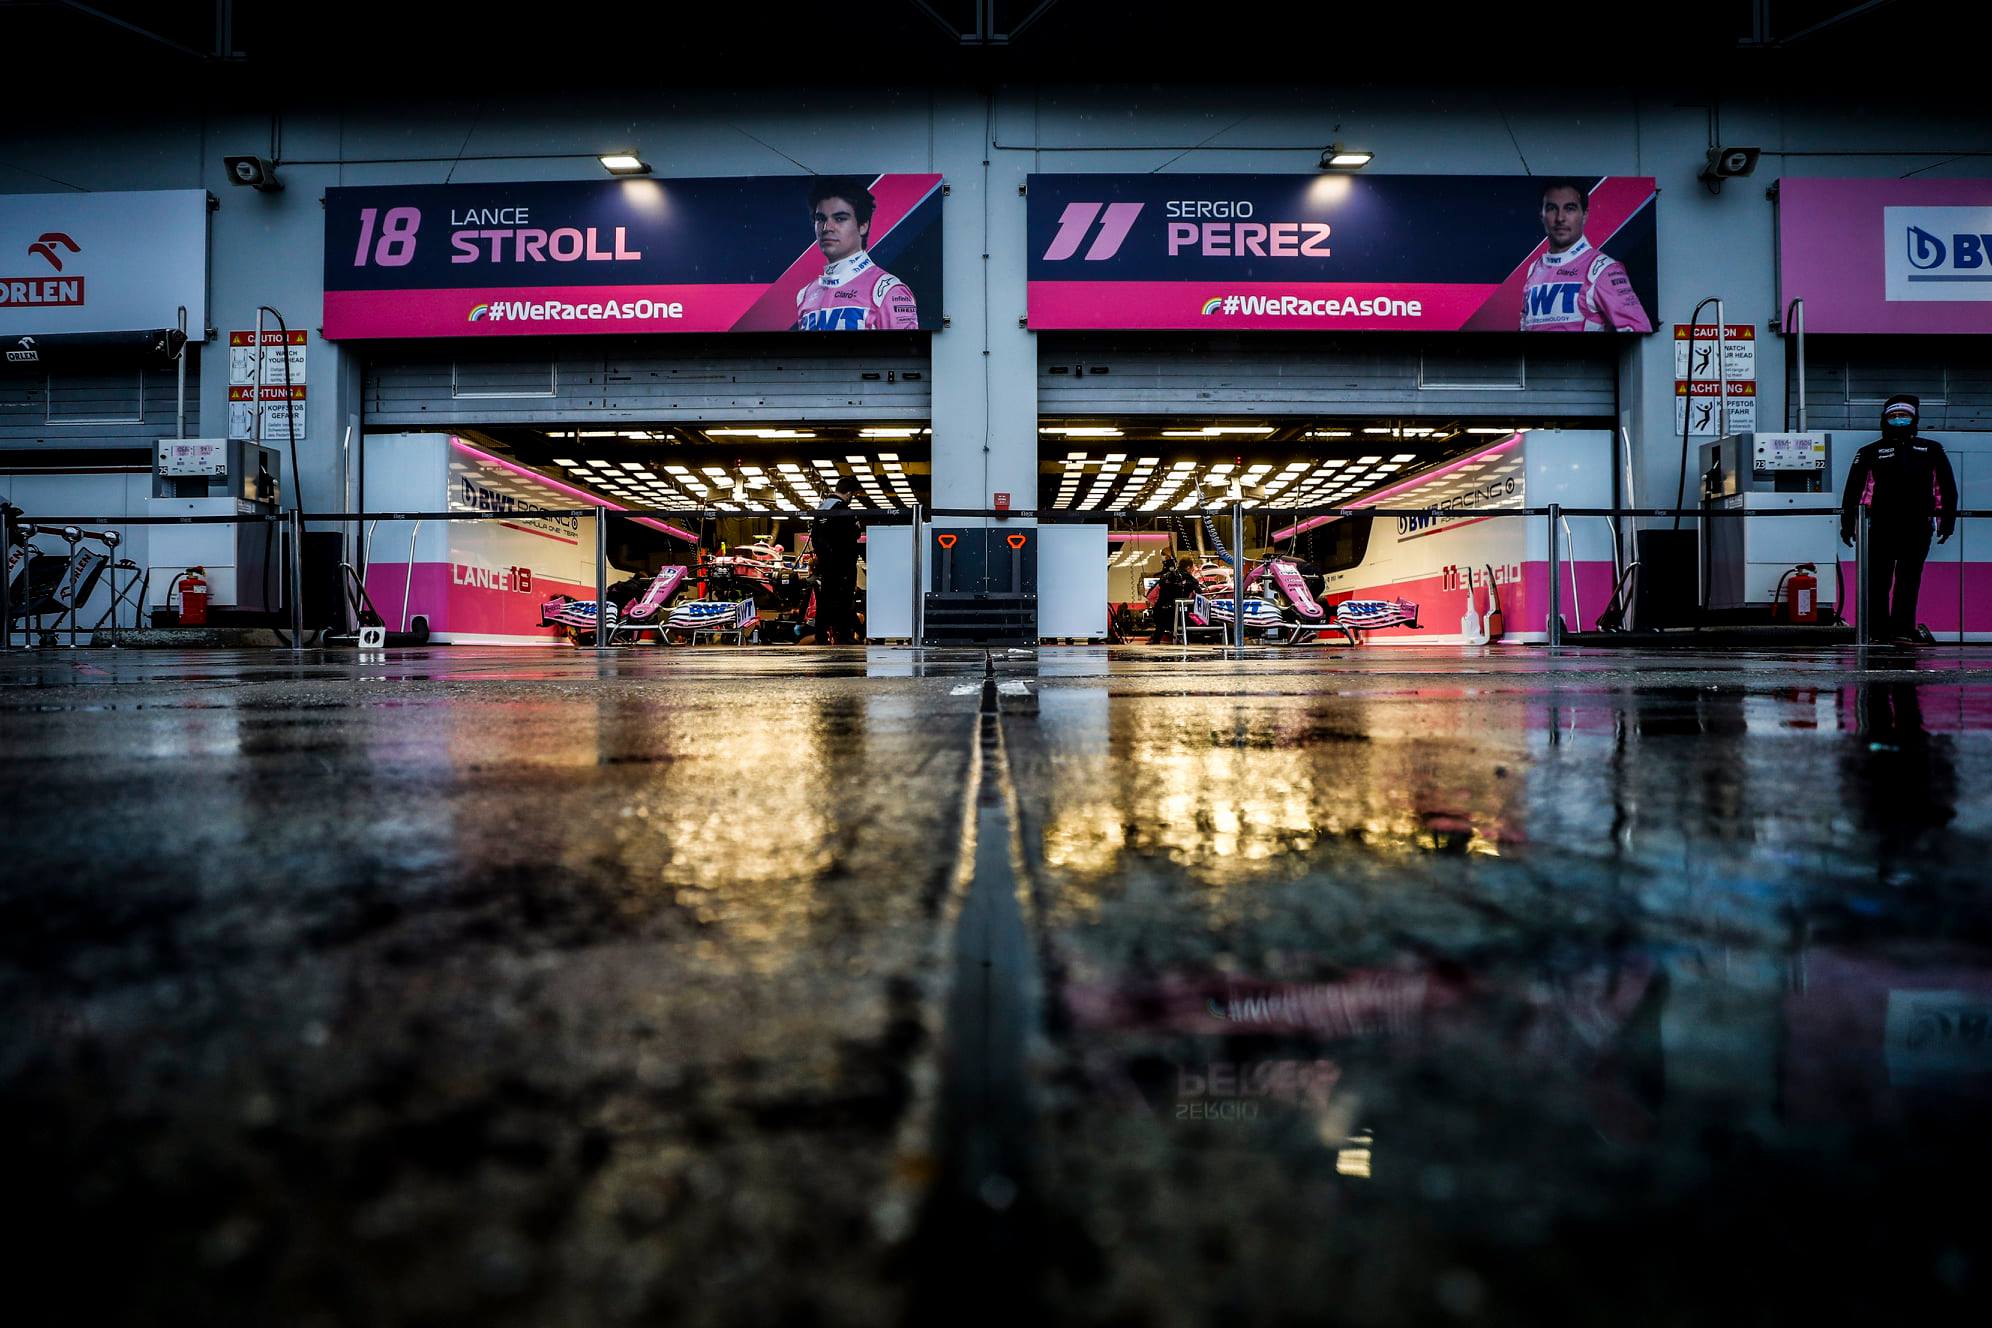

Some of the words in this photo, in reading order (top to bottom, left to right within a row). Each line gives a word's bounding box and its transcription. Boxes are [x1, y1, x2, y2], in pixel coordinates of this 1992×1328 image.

[451, 207, 529, 226] LANCE
[1166, 200, 1253, 218] SERGIO
[353, 206, 422, 267] 18
[1042, 202, 1145, 261] 11
[1167, 222, 1332, 257] PEREZ
[450, 226, 641, 264] STROLL
[1953, 233, 1992, 269] B
[488, 300, 683, 321] #WeRaceAsOne
[1223, 295, 1422, 317] #WeRaceAsOne
[247, 334, 290, 343] CUTIO
[1694, 328, 1737, 338] CAUTON
[8, 352, 37, 361] ORLEN
[1690, 383, 1744, 393] ACHTNG
[1717, 400, 1754, 408] KPFSTOß
[1440, 482, 1503, 511] RACING
[453, 563, 509, 591] LANCE
[511, 565, 532, 593] 18
[1459, 562, 1522, 590] SERGIO
